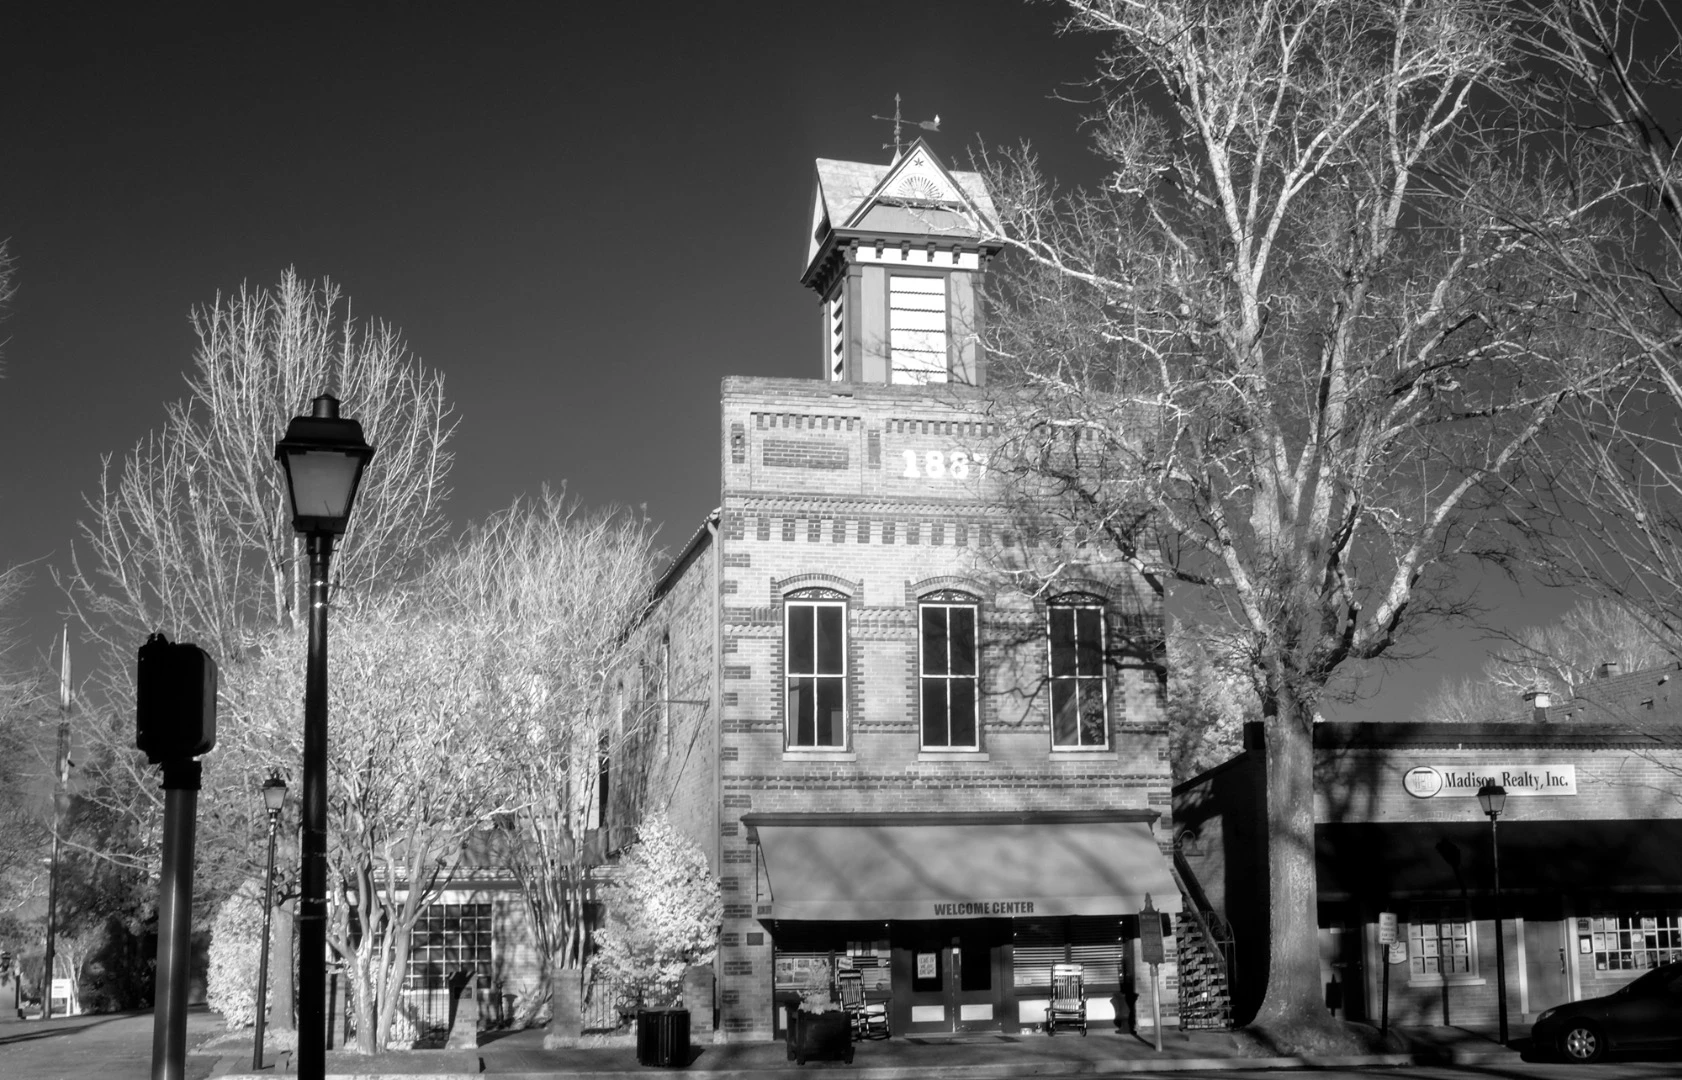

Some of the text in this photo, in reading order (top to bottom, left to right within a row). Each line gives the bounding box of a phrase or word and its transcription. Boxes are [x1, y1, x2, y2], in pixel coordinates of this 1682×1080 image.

[902, 449, 989, 480] 1887
[1501, 770, 1544, 791] Realty,
[1546, 771, 1569, 787] Inc.
[934, 901, 1034, 916] WELCOME CENTER
